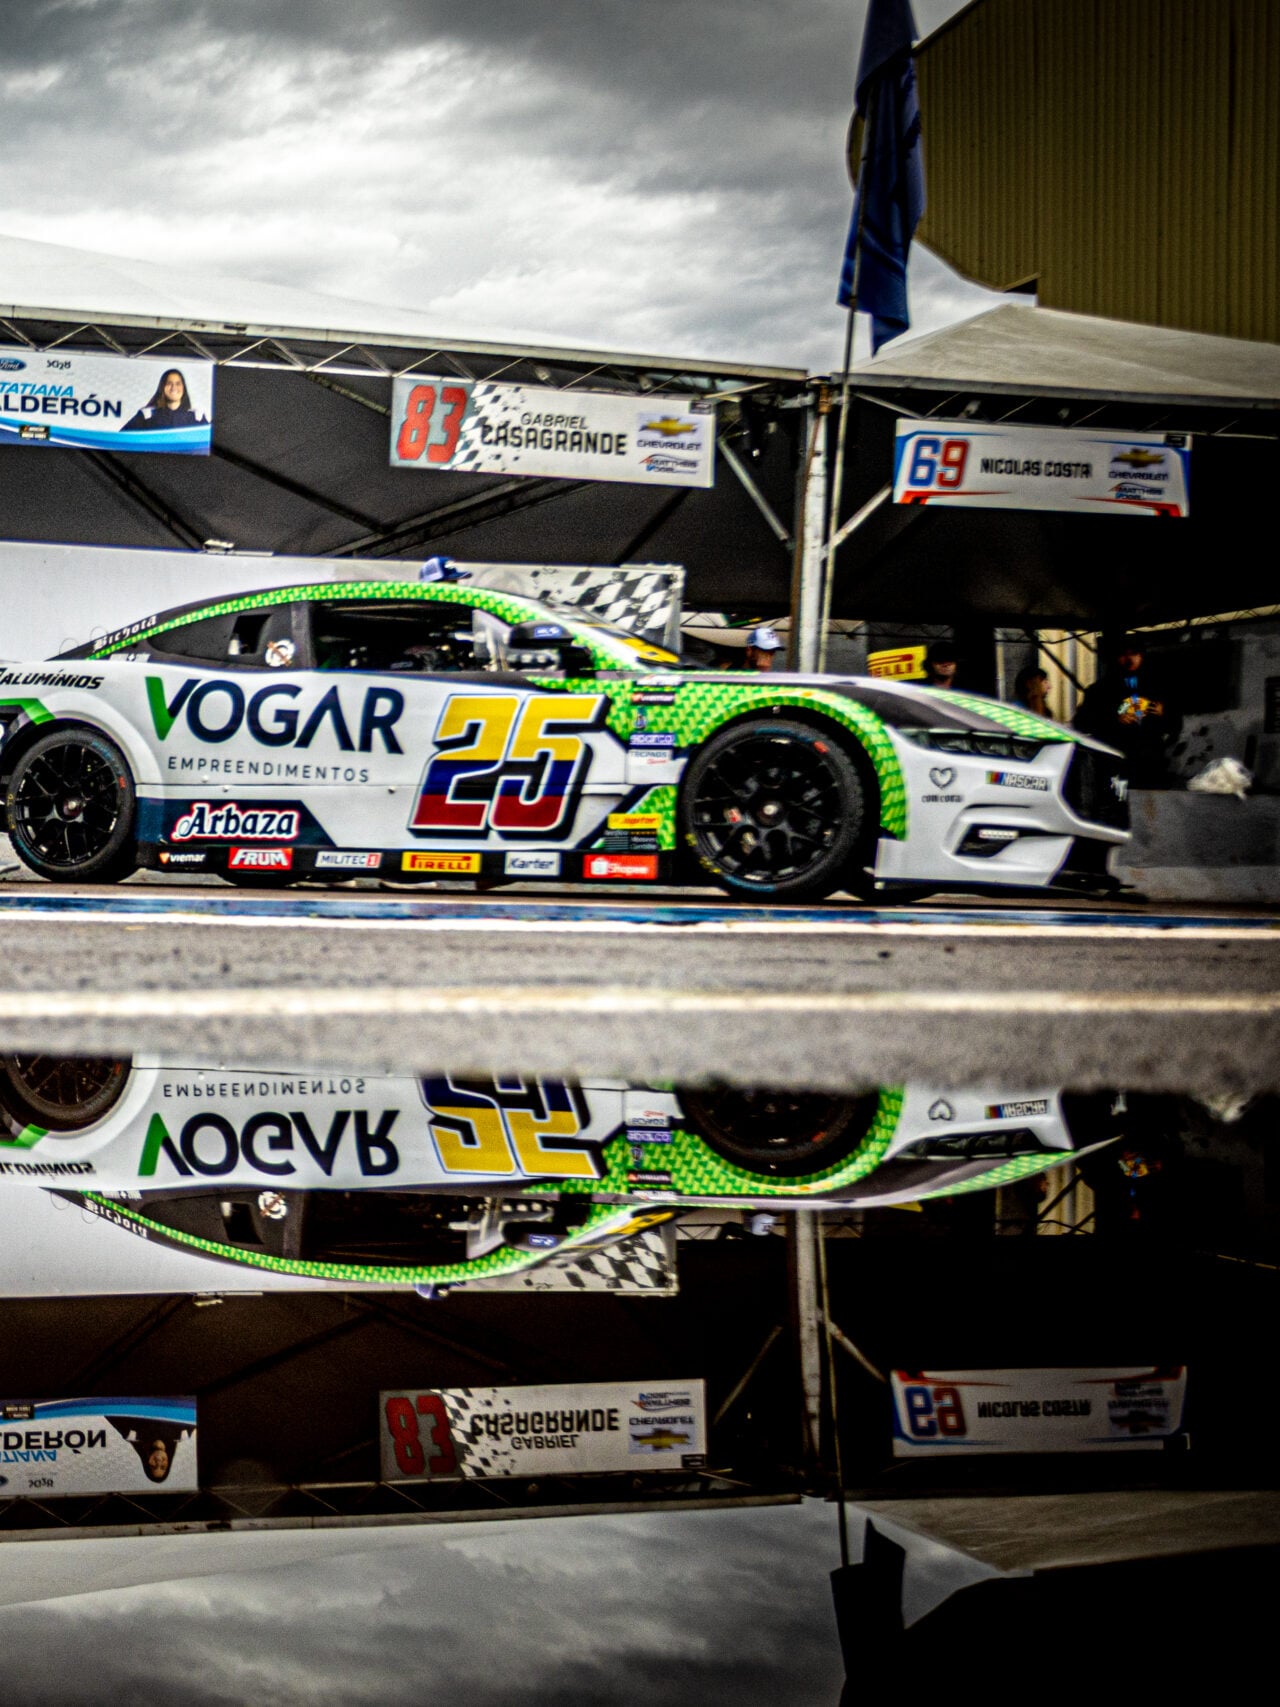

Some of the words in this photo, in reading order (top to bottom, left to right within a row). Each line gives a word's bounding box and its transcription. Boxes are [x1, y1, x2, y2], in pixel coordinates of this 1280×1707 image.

[396, 384, 469, 463] 83
[520, 412, 588, 430] GABRIEL
[480, 424, 628, 456] CASAGRANDE
[636, 439, 702, 451] CHEVROLET
[907, 436, 969, 490] 69
[980, 457, 1042, 477] NICOLAS
[1043, 460, 1093, 479] COSTA
[1108, 471, 1169, 480] CHEVROLET
[144, 676, 405, 754] VOGAR
[167, 756, 370, 783] EMPREENDIMENTOS
[407, 693, 610, 840] 25
[1002, 772, 1049, 791] NASCAR
[174, 804, 297, 839] Arbaza
[169, 851, 206, 866] viemar
[231, 849, 288, 867] FRUM
[407, 855, 473, 872] PIRELLI
[508, 857, 555, 872] Karter
[607, 862, 650, 875] Shopee
